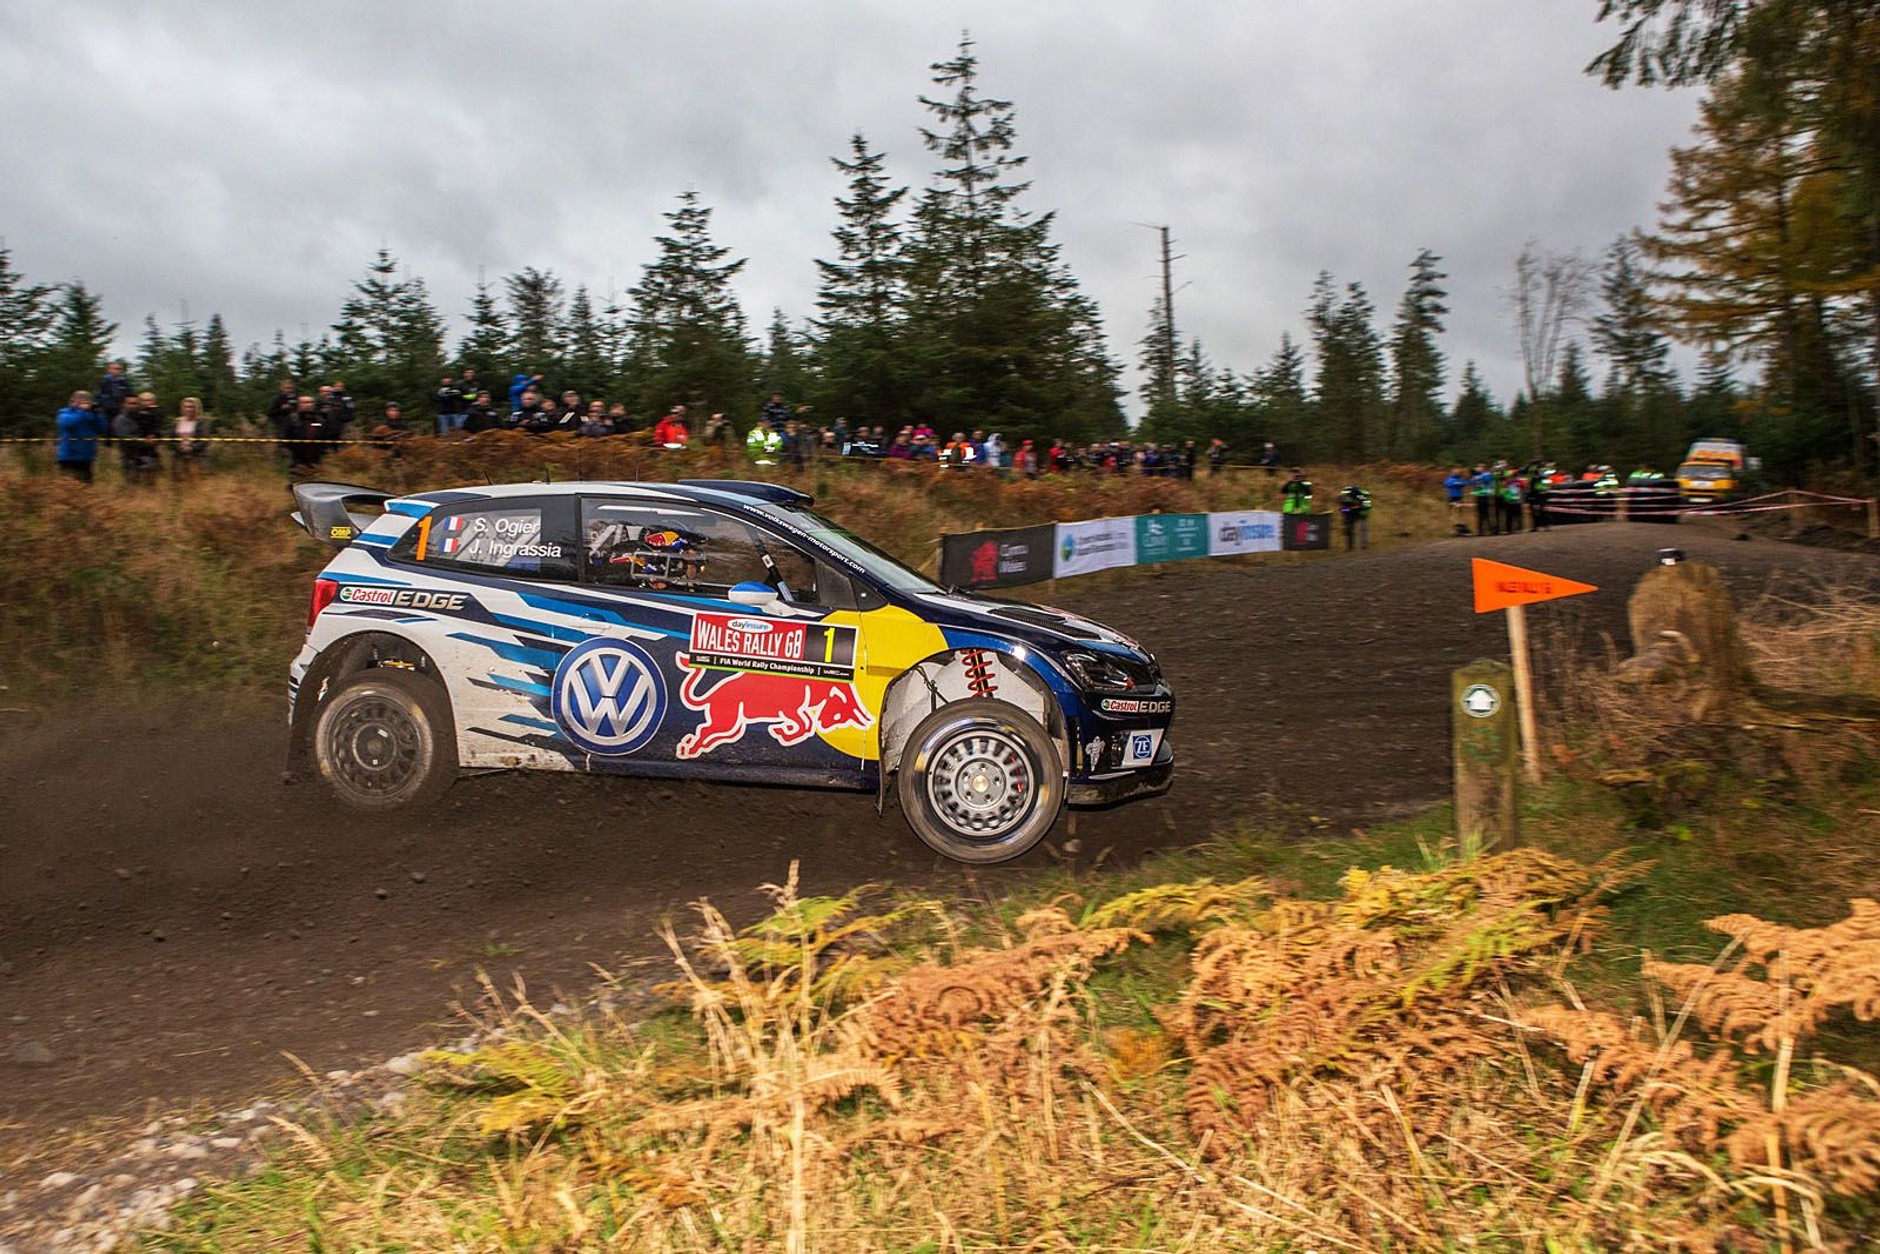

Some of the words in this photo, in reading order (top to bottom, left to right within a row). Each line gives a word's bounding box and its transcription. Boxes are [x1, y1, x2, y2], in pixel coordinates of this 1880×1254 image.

[416, 515, 433, 561] 1
[473, 517, 489, 533] S.
[494, 518, 541, 537] Ogier
[469, 540, 483, 555] J.
[488, 540, 562, 558] Ingrassia
[743, 504, 866, 574] www.volkswagen-motorsport.com
[351, 588, 394, 604] Castrol
[394, 590, 469, 611] EDGE
[697, 619, 741, 652] WALES
[743, 629, 784, 657] RALLY
[785, 629, 803, 659] GB
[823, 627, 836, 663] 1
[720, 657, 731, 665] FIA
[732, 658, 750, 667] World
[752, 660, 768, 670] Rally
[769, 662, 815, 675] Championship
[1110, 700, 1138, 711] Castrol
[1139, 701, 1171, 713] EDGE
